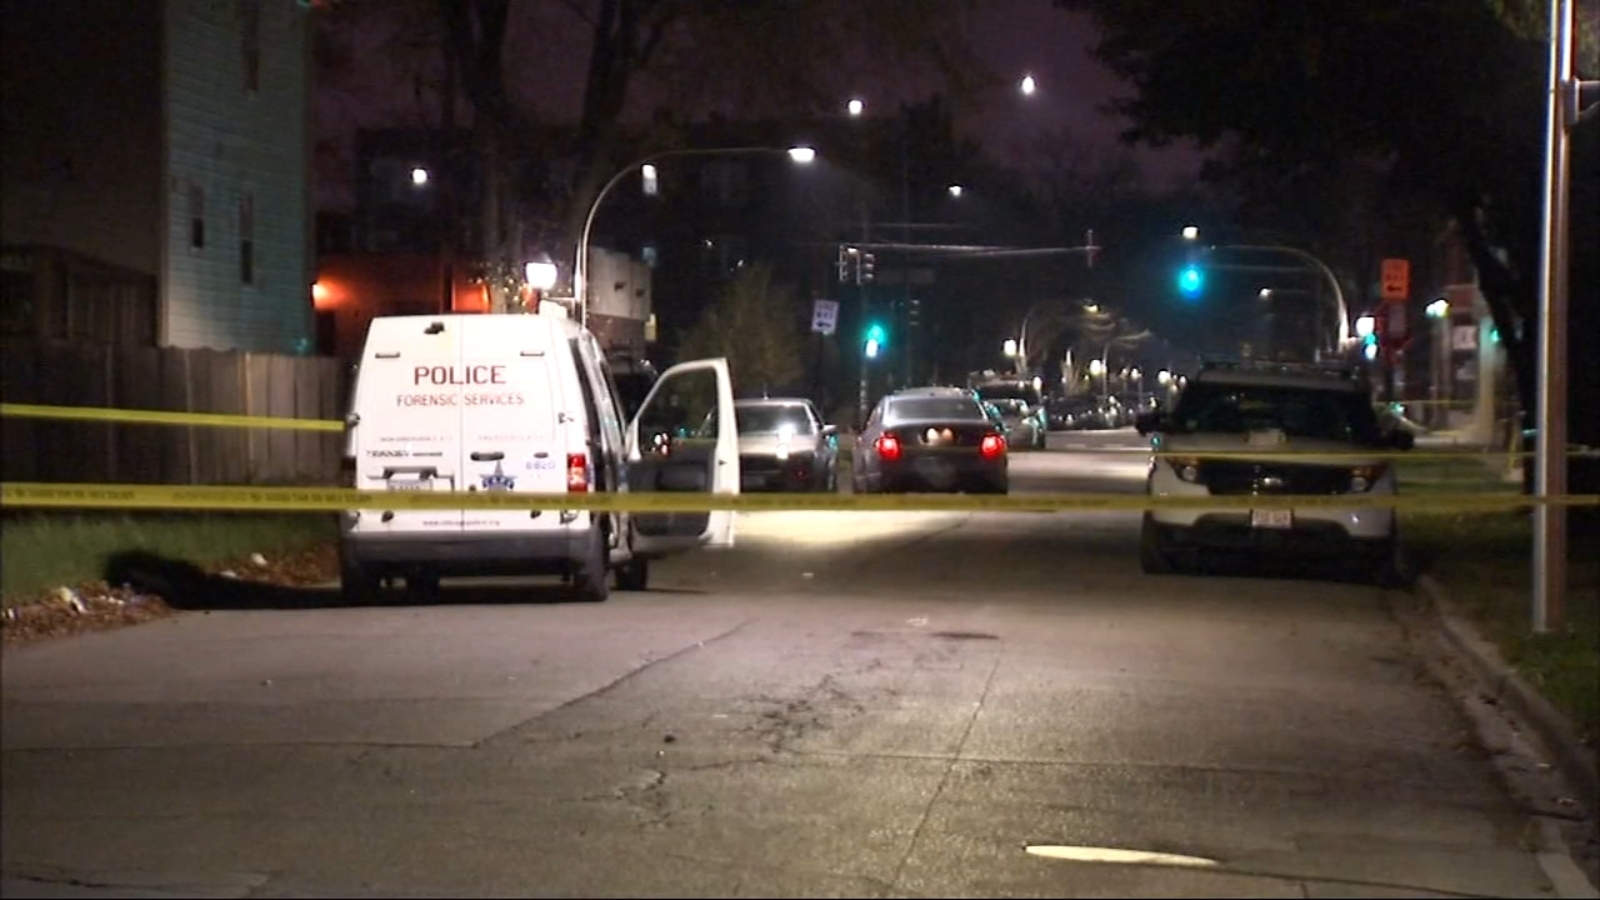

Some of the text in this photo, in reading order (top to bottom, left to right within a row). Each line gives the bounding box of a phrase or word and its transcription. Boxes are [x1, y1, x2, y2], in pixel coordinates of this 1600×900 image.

[414, 366, 507, 386] POLICE
[397, 394, 525, 407] FORENSIC SERVICES
